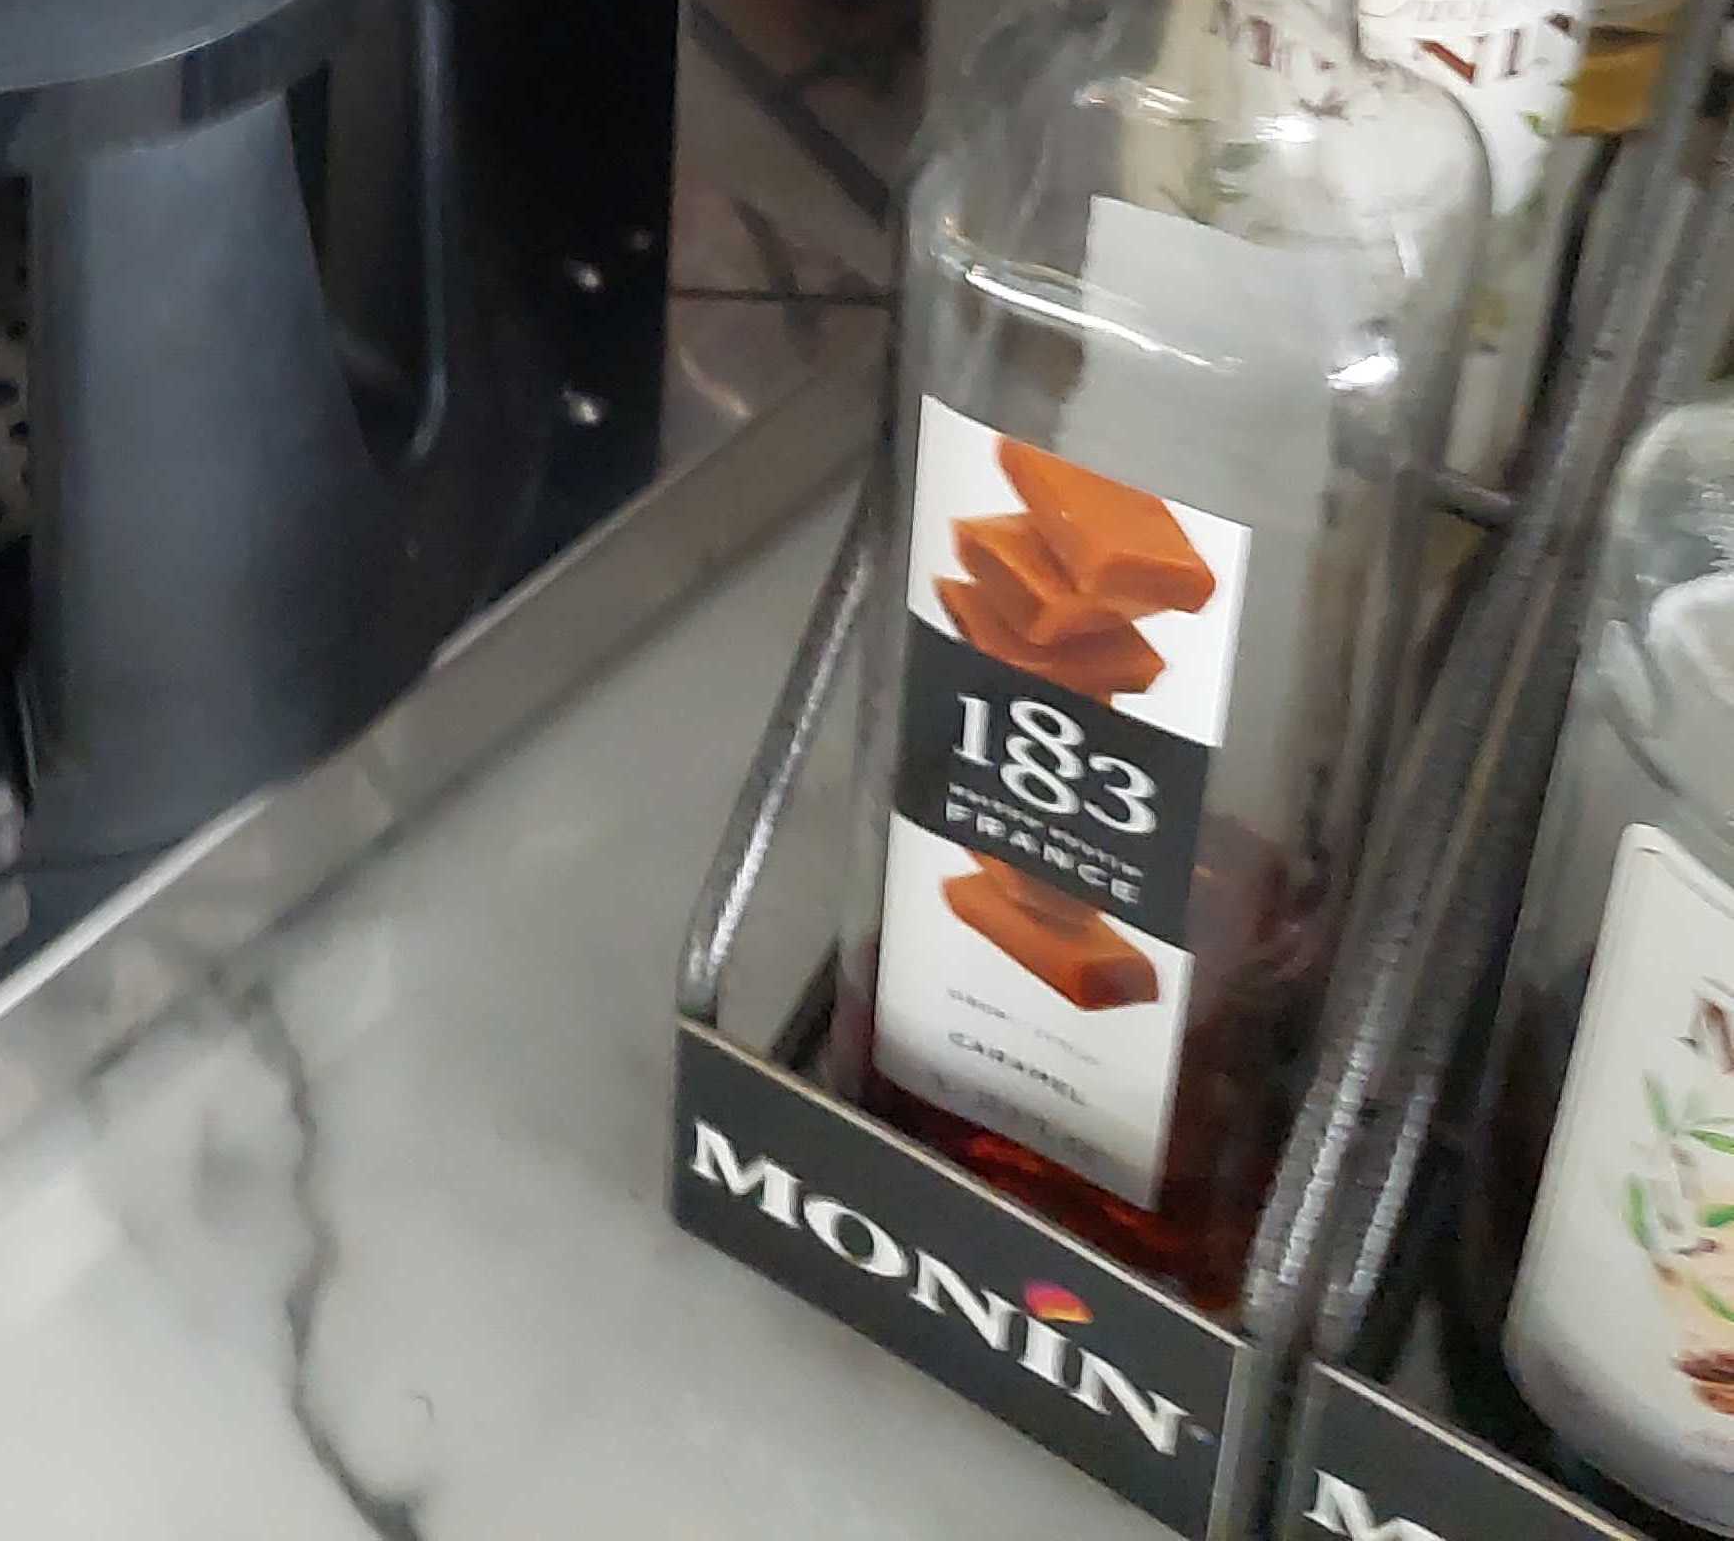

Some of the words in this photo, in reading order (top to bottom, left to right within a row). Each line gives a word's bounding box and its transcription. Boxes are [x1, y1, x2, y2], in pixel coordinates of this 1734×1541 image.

[946, 799, 1141, 905] FRANCE
[948, 1032, 1087, 1107] CARAMEL
[691, 1117, 1190, 1457] MONIN
